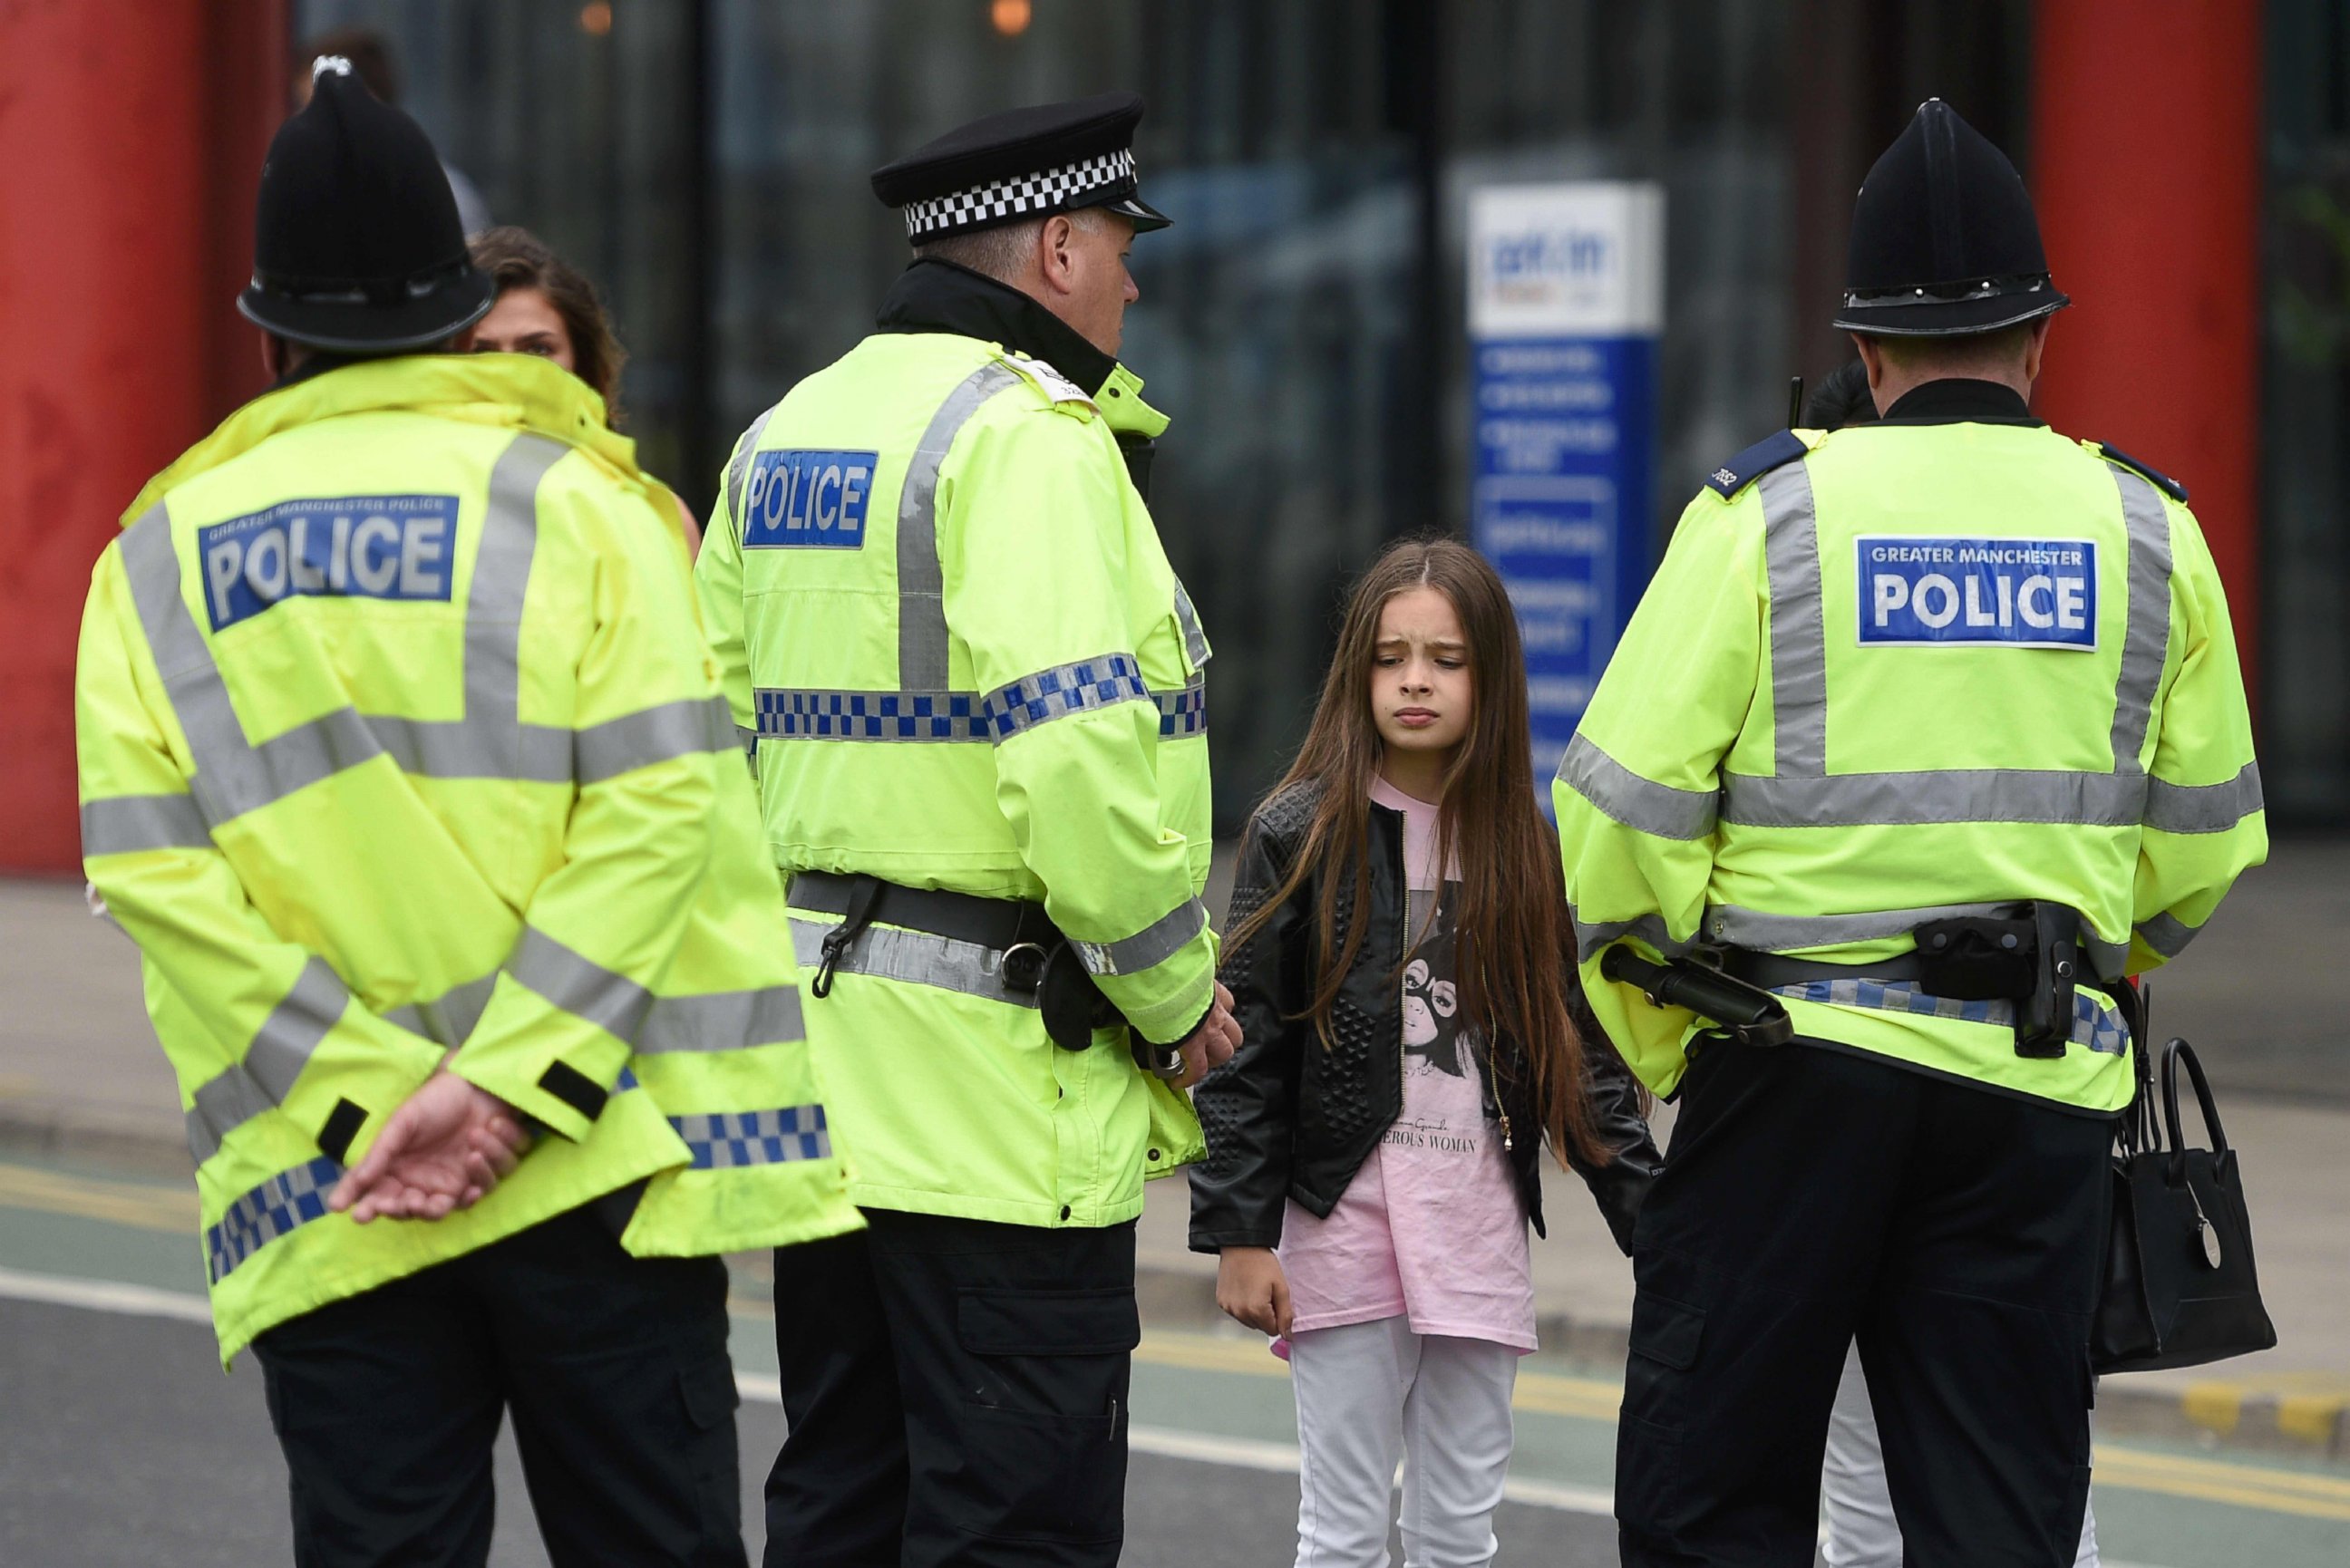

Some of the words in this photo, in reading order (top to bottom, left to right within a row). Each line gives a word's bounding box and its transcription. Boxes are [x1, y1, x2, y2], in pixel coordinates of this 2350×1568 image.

[209, 510, 273, 540] GREATER
[276, 499, 384, 516] MANCHESTER
[387, 498, 444, 510] POLICE
[747, 464, 868, 530] POLICE
[208, 516, 446, 623] POLICE
[1871, 547, 1955, 563] GREATER
[1958, 547, 2083, 566] MANCHESTER
[1873, 573, 2086, 630] POLICE
[1383, 1129, 1424, 1147] EROUS
[1429, 1135, 1476, 1153] WOMAN
